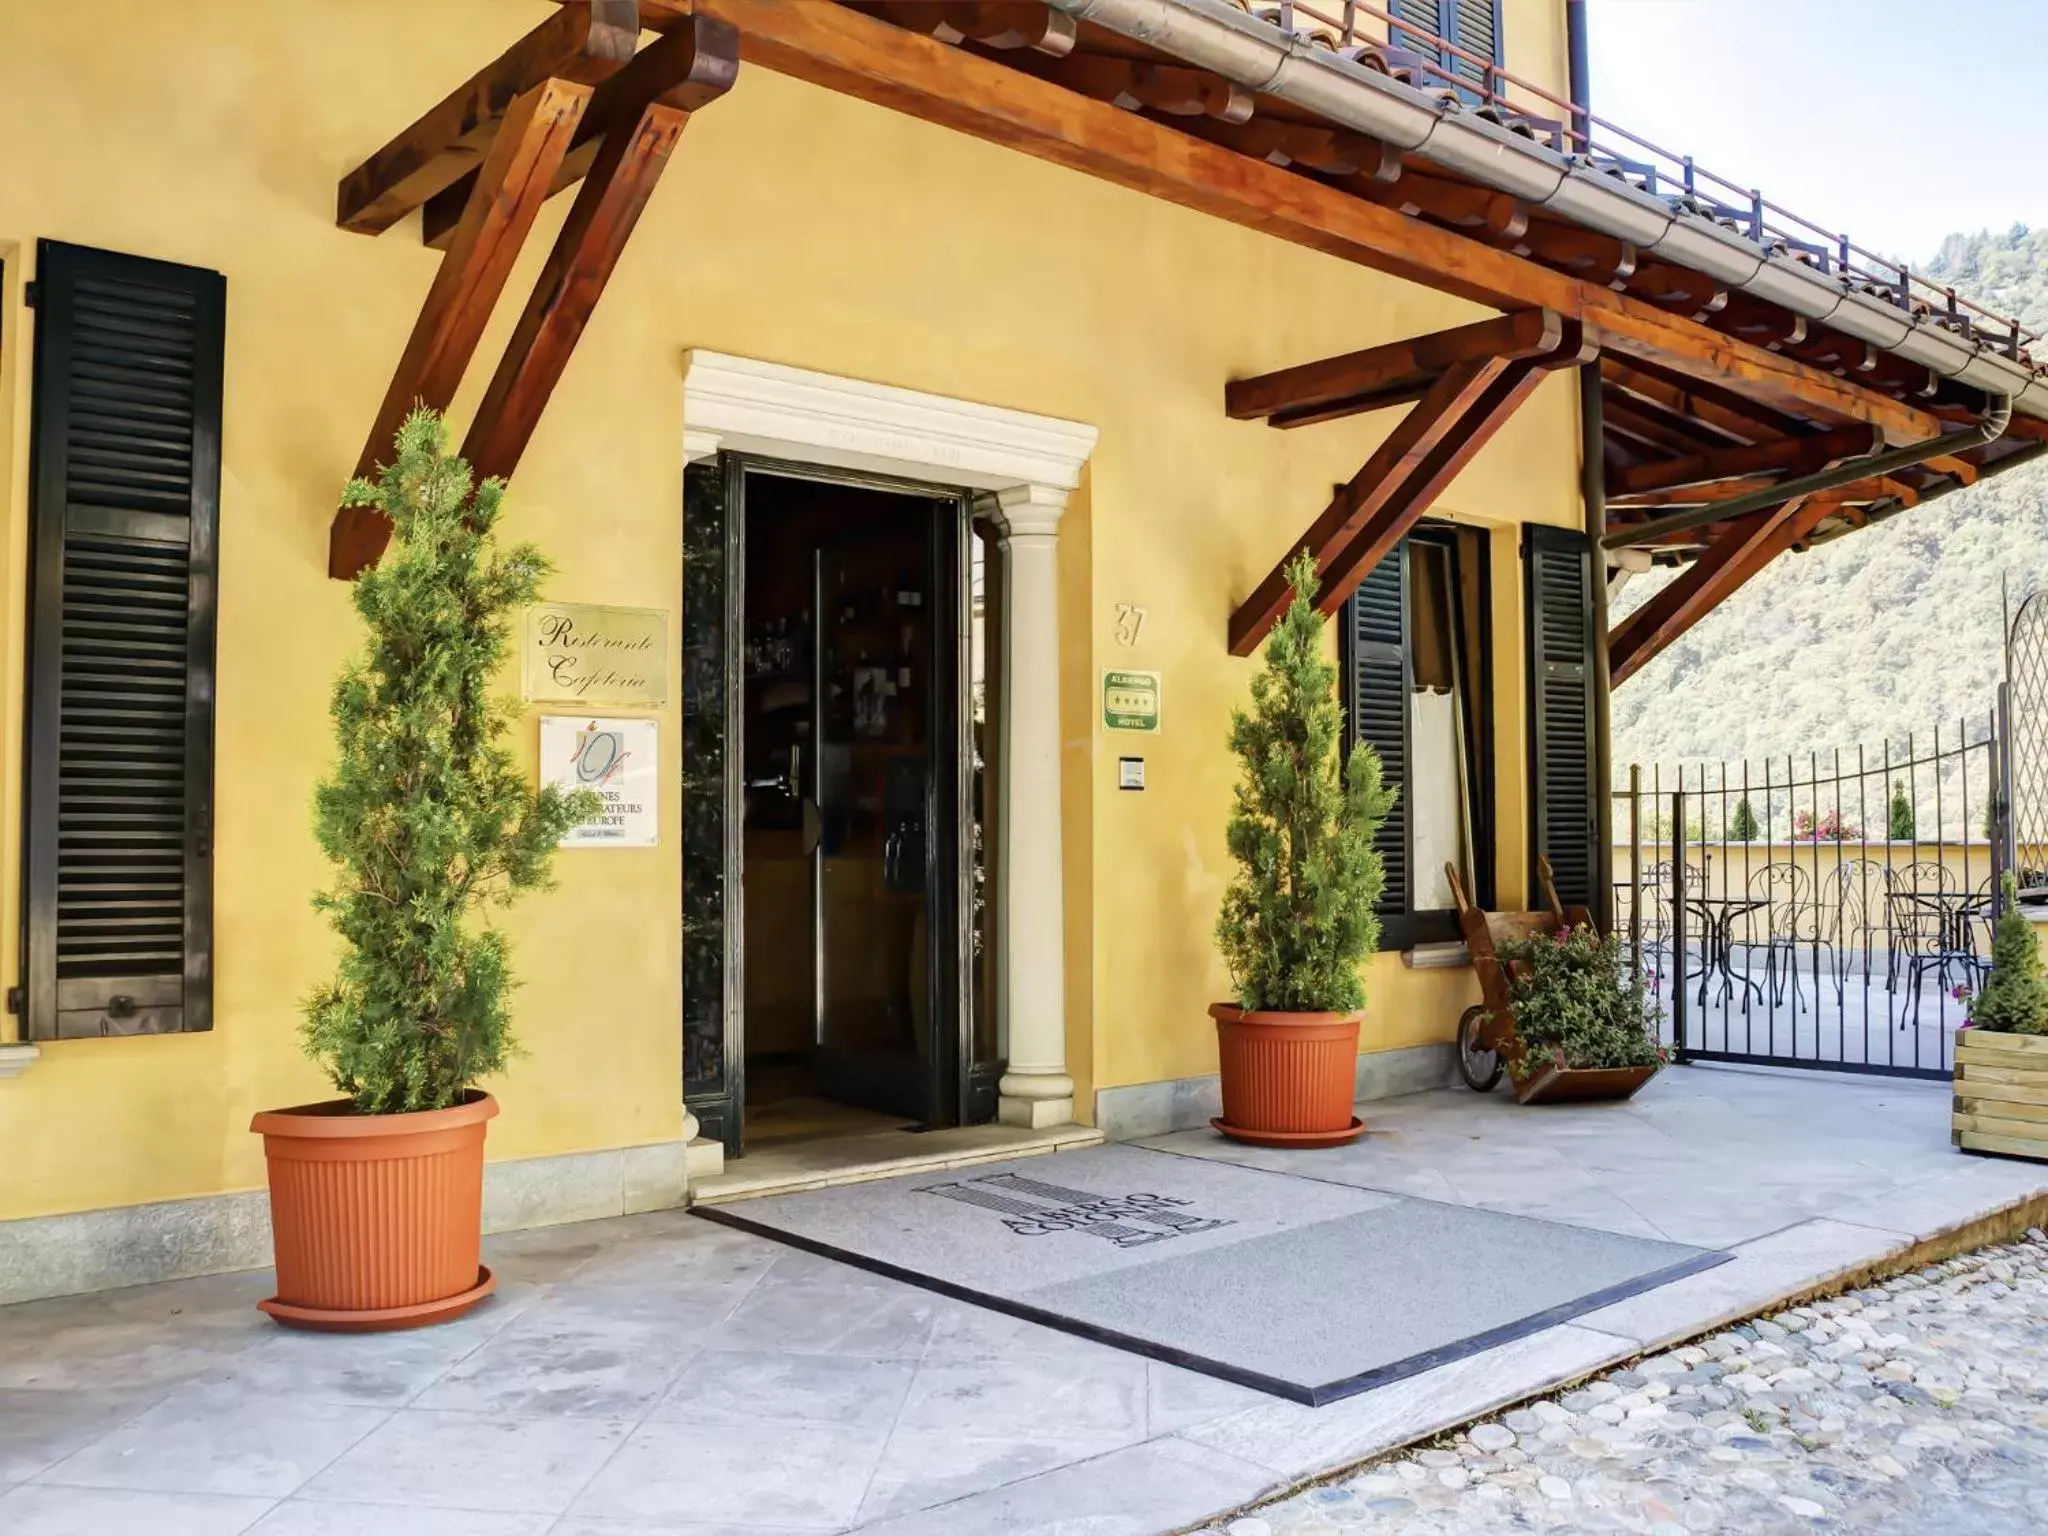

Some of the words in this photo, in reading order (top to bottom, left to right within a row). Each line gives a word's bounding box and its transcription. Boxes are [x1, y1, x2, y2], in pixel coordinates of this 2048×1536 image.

[538, 614, 654, 651] Ristorante
[1114, 602, 1146, 648] 37
[1110, 674, 1152, 686] ALBERGO
[1117, 718, 1146, 728] HOTEL
[596, 791, 621, 801] NES
[1001, 1192, 1160, 1230] ALBERGO
[1013, 1196, 1195, 1236] COLONNE
